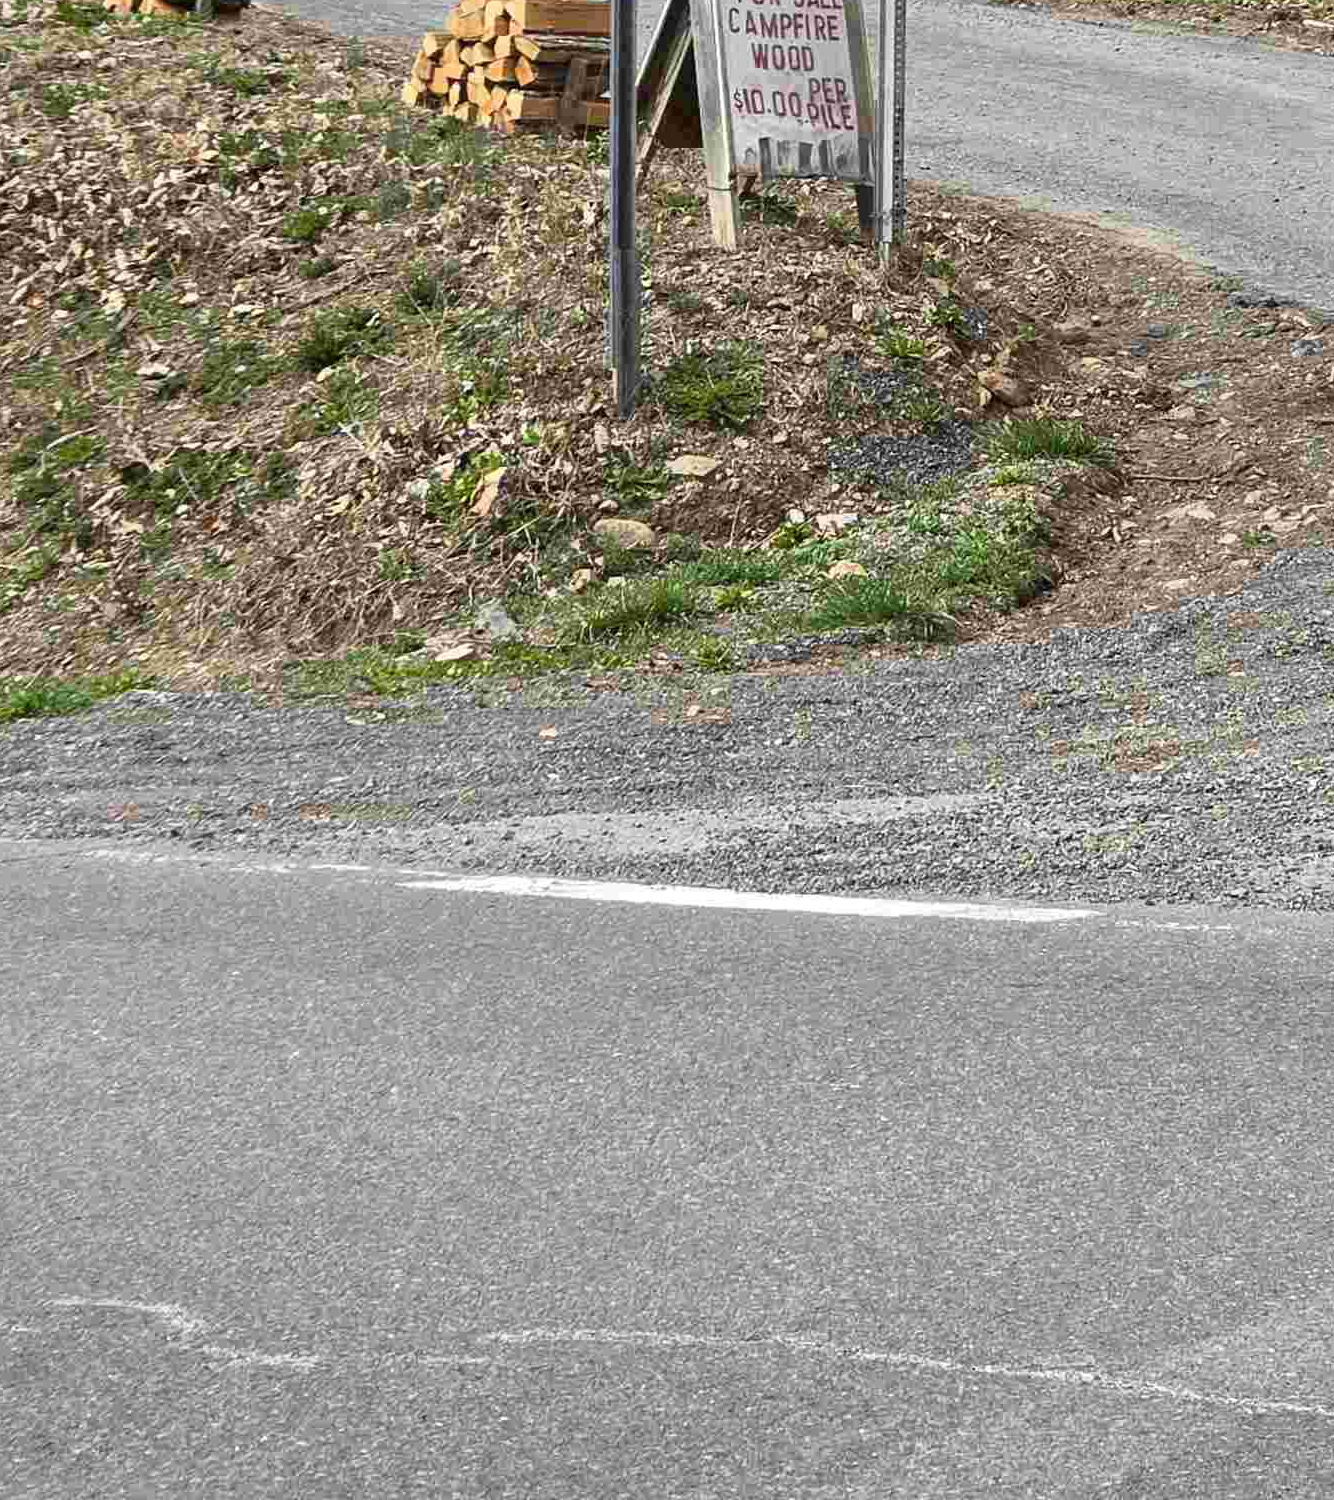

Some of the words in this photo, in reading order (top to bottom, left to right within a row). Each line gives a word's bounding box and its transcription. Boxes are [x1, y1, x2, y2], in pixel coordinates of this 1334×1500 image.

[728, 7, 841, 42] CAMPFIRE
[751, 43, 814, 72] WOOD
[733, 87, 802, 118] $10.00
[808, 77, 848, 104] PER
[806, 102, 855, 131] PILE
